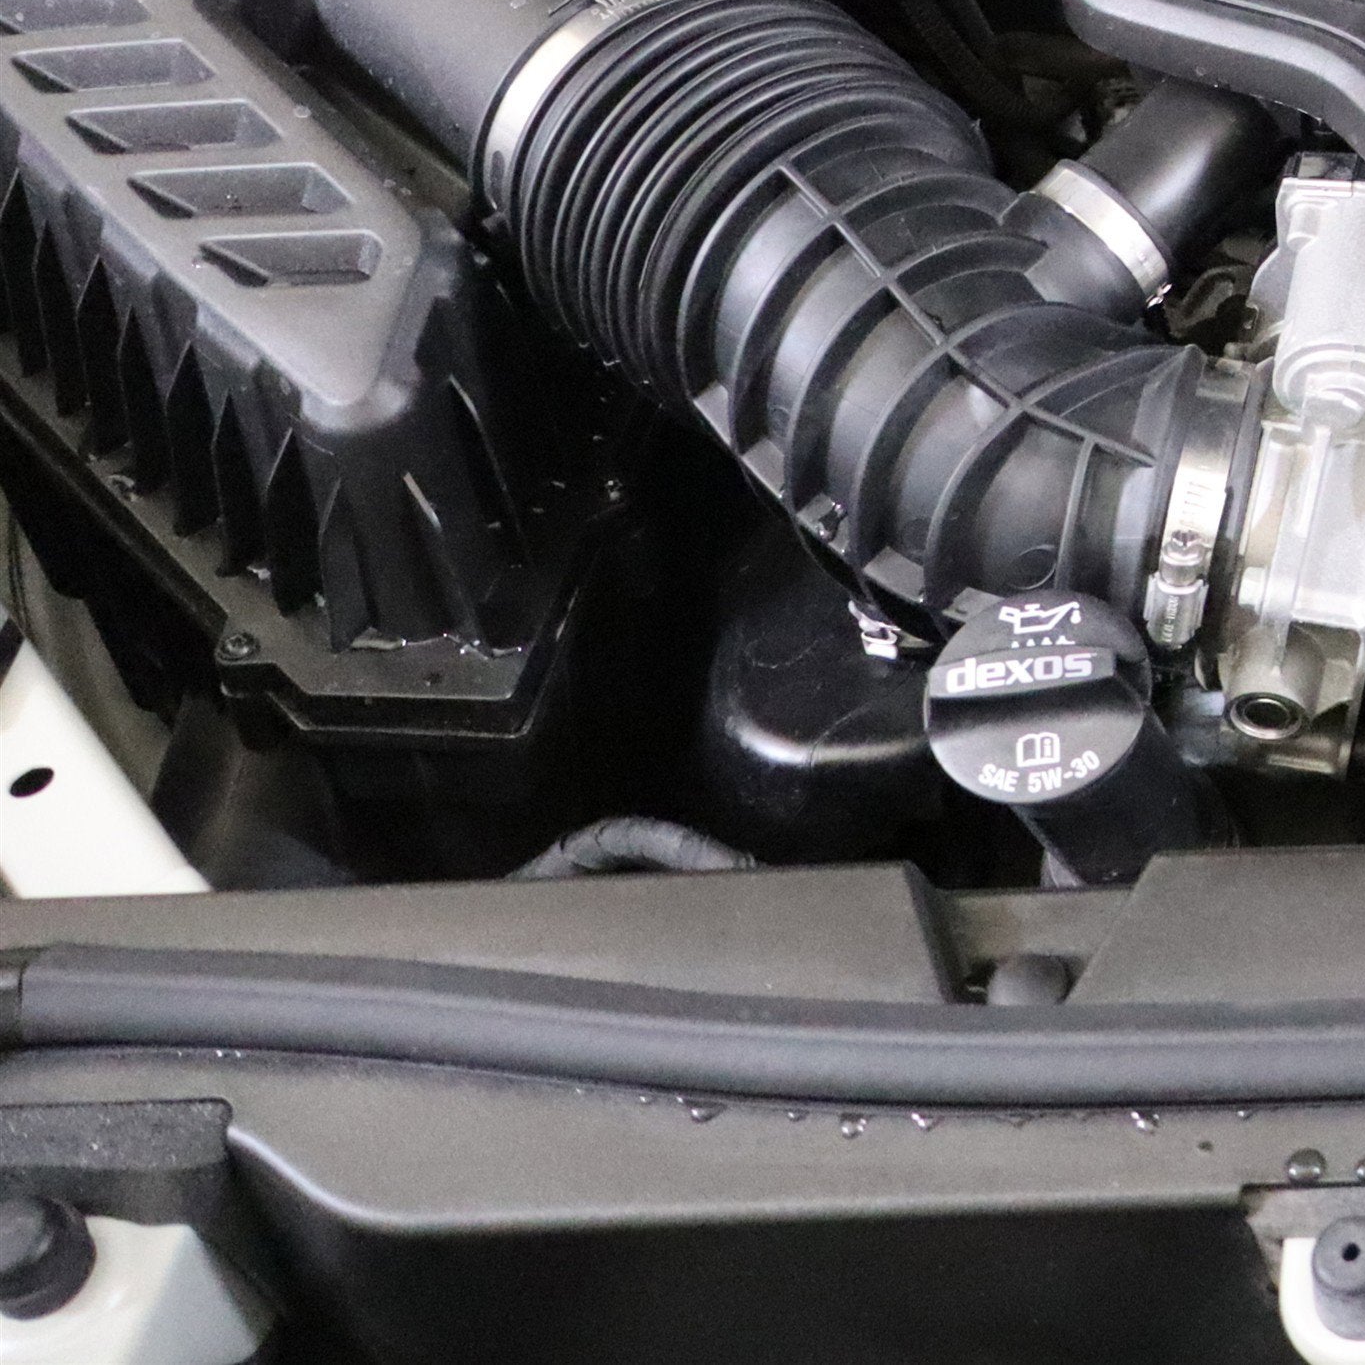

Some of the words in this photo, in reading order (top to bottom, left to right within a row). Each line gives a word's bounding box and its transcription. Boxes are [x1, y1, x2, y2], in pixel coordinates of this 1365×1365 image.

[946, 652, 1093, 694] dexos
[978, 763, 1019, 793] SAE
[1027, 749, 1101, 794] 5W-30
